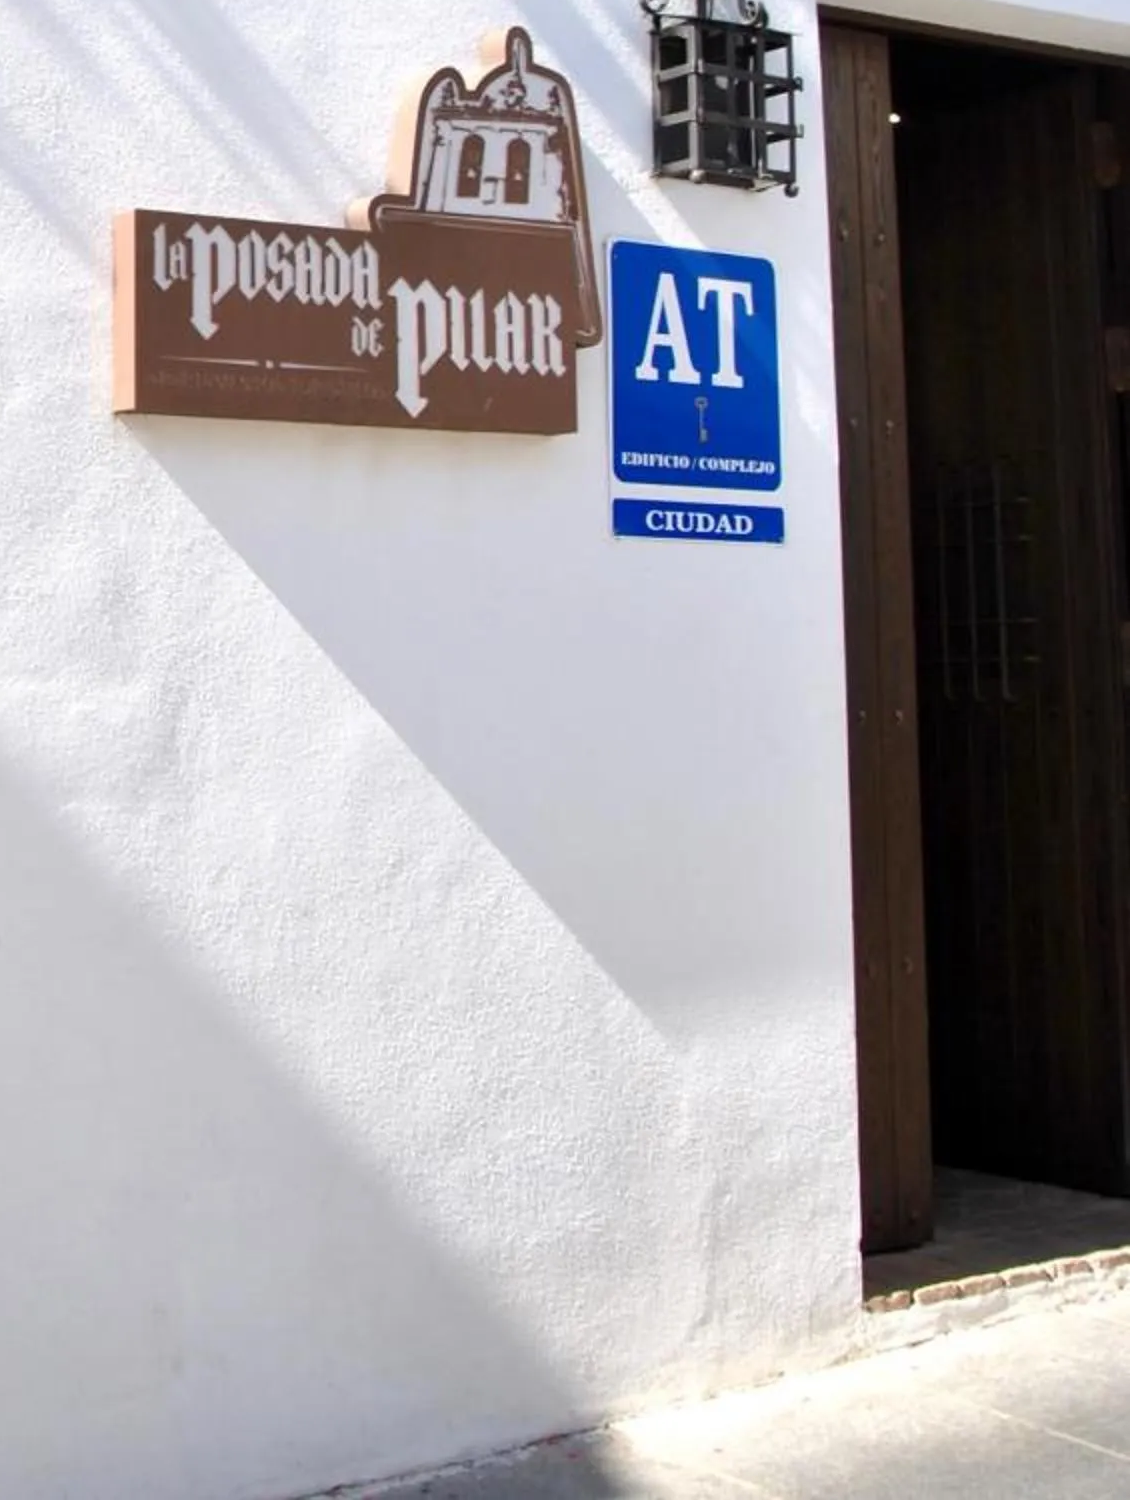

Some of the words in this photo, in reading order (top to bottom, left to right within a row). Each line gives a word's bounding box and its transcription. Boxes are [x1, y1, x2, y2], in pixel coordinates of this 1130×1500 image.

[153, 222, 188, 292] LA
[185, 221, 384, 341] POSADA
[635, 272, 755, 389] AT
[351, 315, 385, 358] DE
[387, 276, 567, 419] PILAR
[621, 451, 689, 470] EDIFICIO
[699, 455, 775, 475] COMPLEJO
[645, 509, 754, 536] CIUDAD
